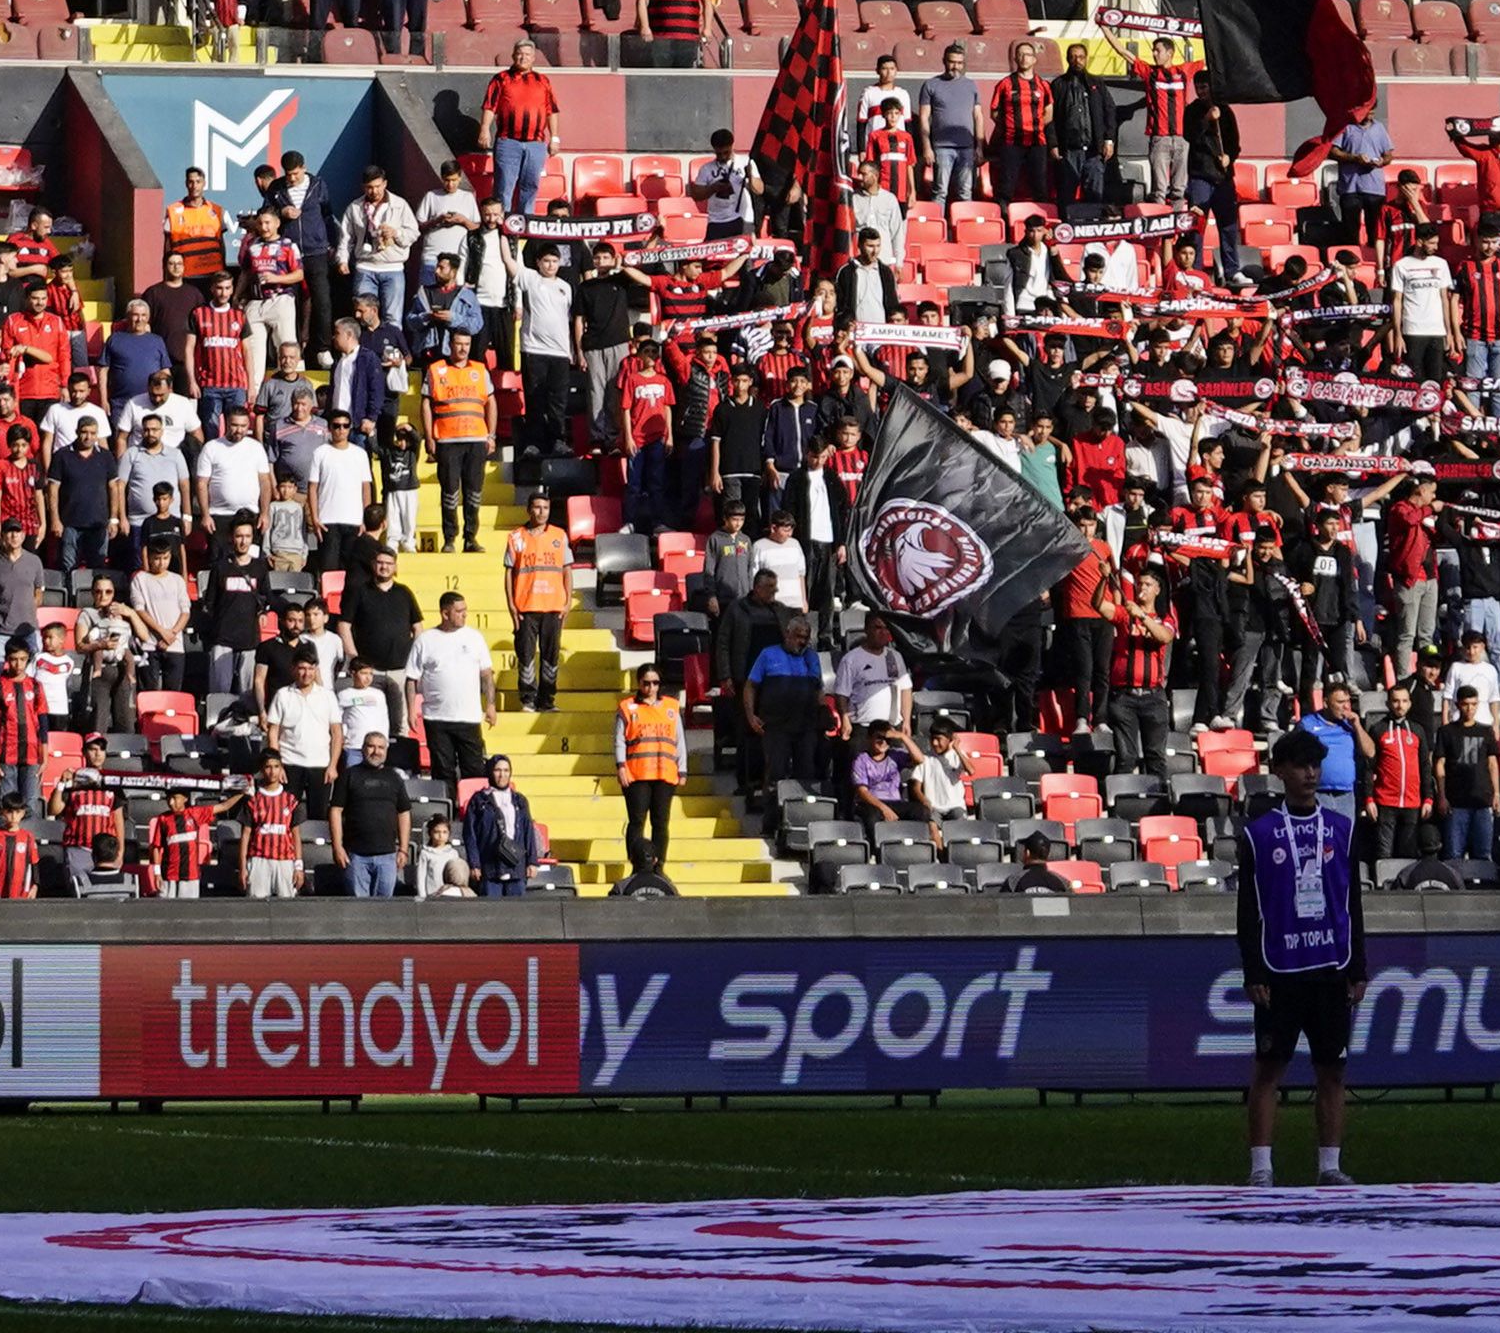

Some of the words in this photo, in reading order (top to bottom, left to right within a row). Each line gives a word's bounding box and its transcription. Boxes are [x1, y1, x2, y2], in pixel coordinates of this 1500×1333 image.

[1075, 222, 1131, 237] NEVZAT
[172, 958, 540, 1087] trendyol
[710, 945, 1051, 1086] sport
